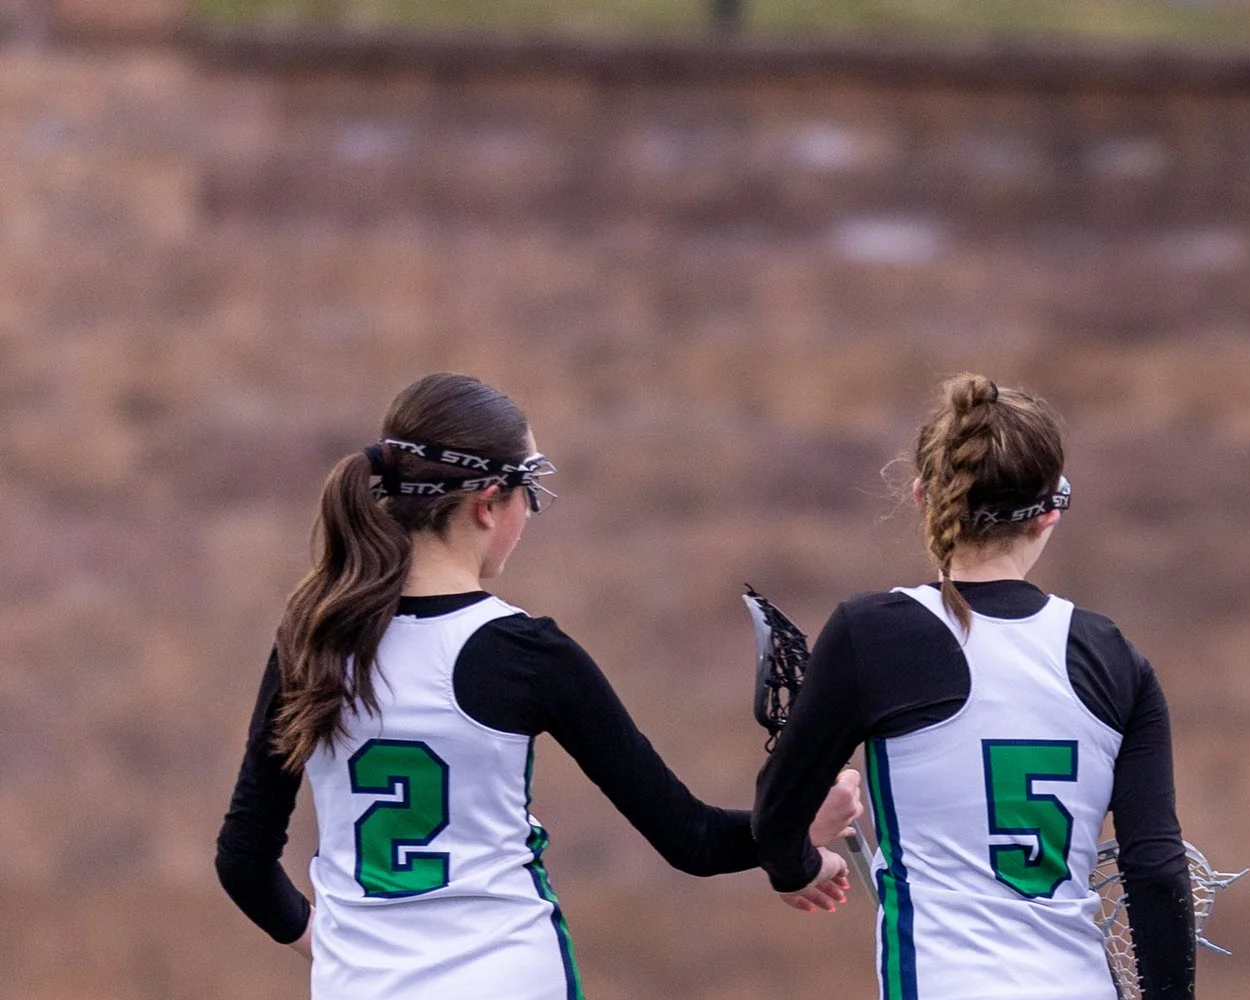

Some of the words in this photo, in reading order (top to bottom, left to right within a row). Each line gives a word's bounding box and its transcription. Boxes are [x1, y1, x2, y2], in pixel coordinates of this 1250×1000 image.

[441, 450, 491, 471] STX
[400, 482, 446, 495] STX
[462, 474, 508, 491] STX
[1011, 501, 1046, 521] STX
[1052, 494, 1069, 508] STX
[347, 738, 450, 898] 2
[981, 739, 1078, 899] 5
